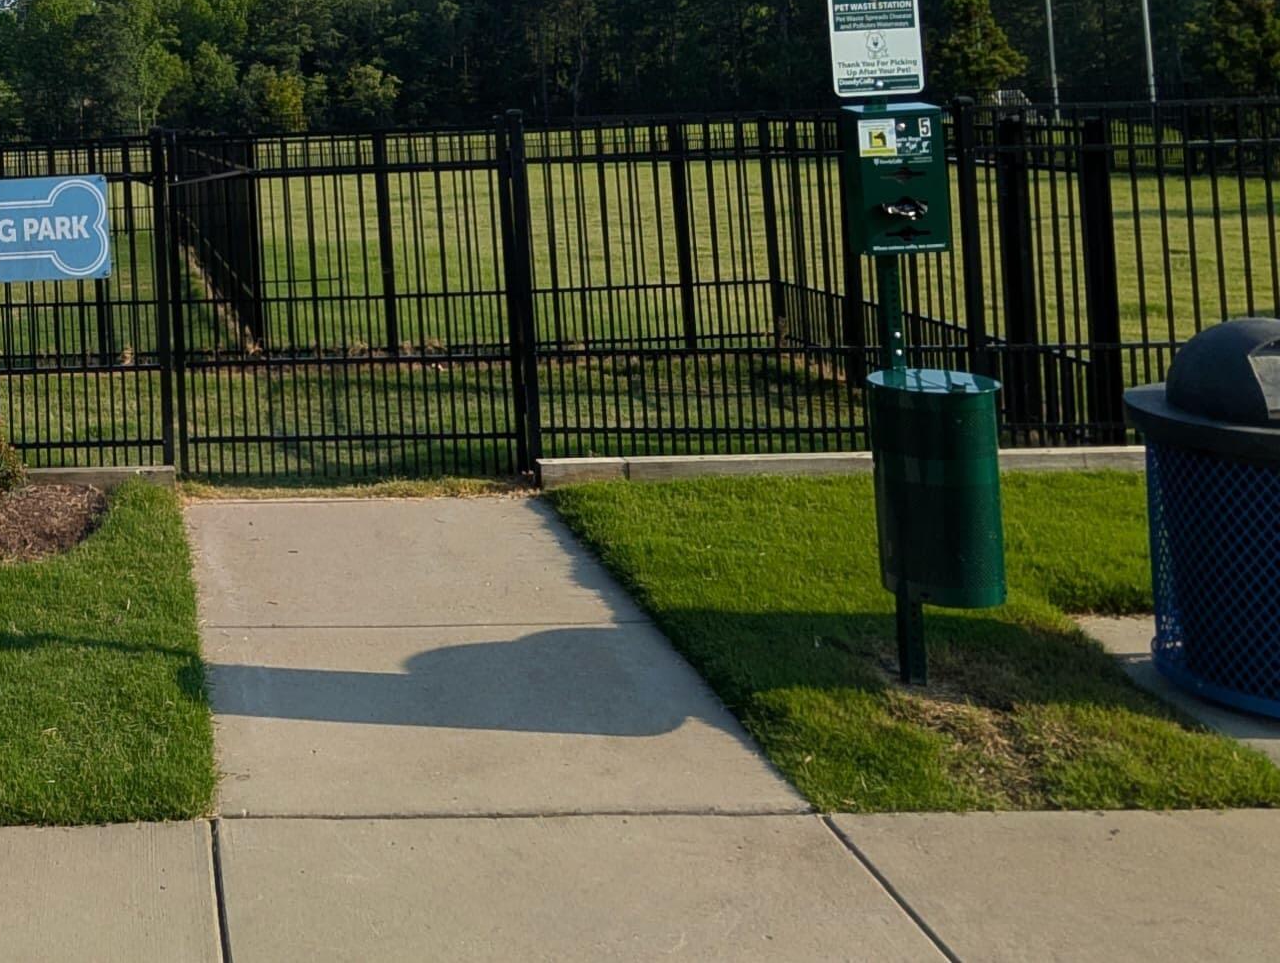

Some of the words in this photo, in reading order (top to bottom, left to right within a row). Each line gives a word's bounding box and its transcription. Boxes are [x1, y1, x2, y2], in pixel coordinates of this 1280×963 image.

[834, 3, 849, 12] PET
[850, 2, 878, 11] WASTE
[878, 0, 913, 9] STATION
[838, 60, 860, 68] Thank
[877, 59, 889, 67] For
[890, 58, 918, 66] Picking
[846, 69, 857, 77] Up
[920, 118, 930, 136] 5
[23, 215, 90, 242] PARK
